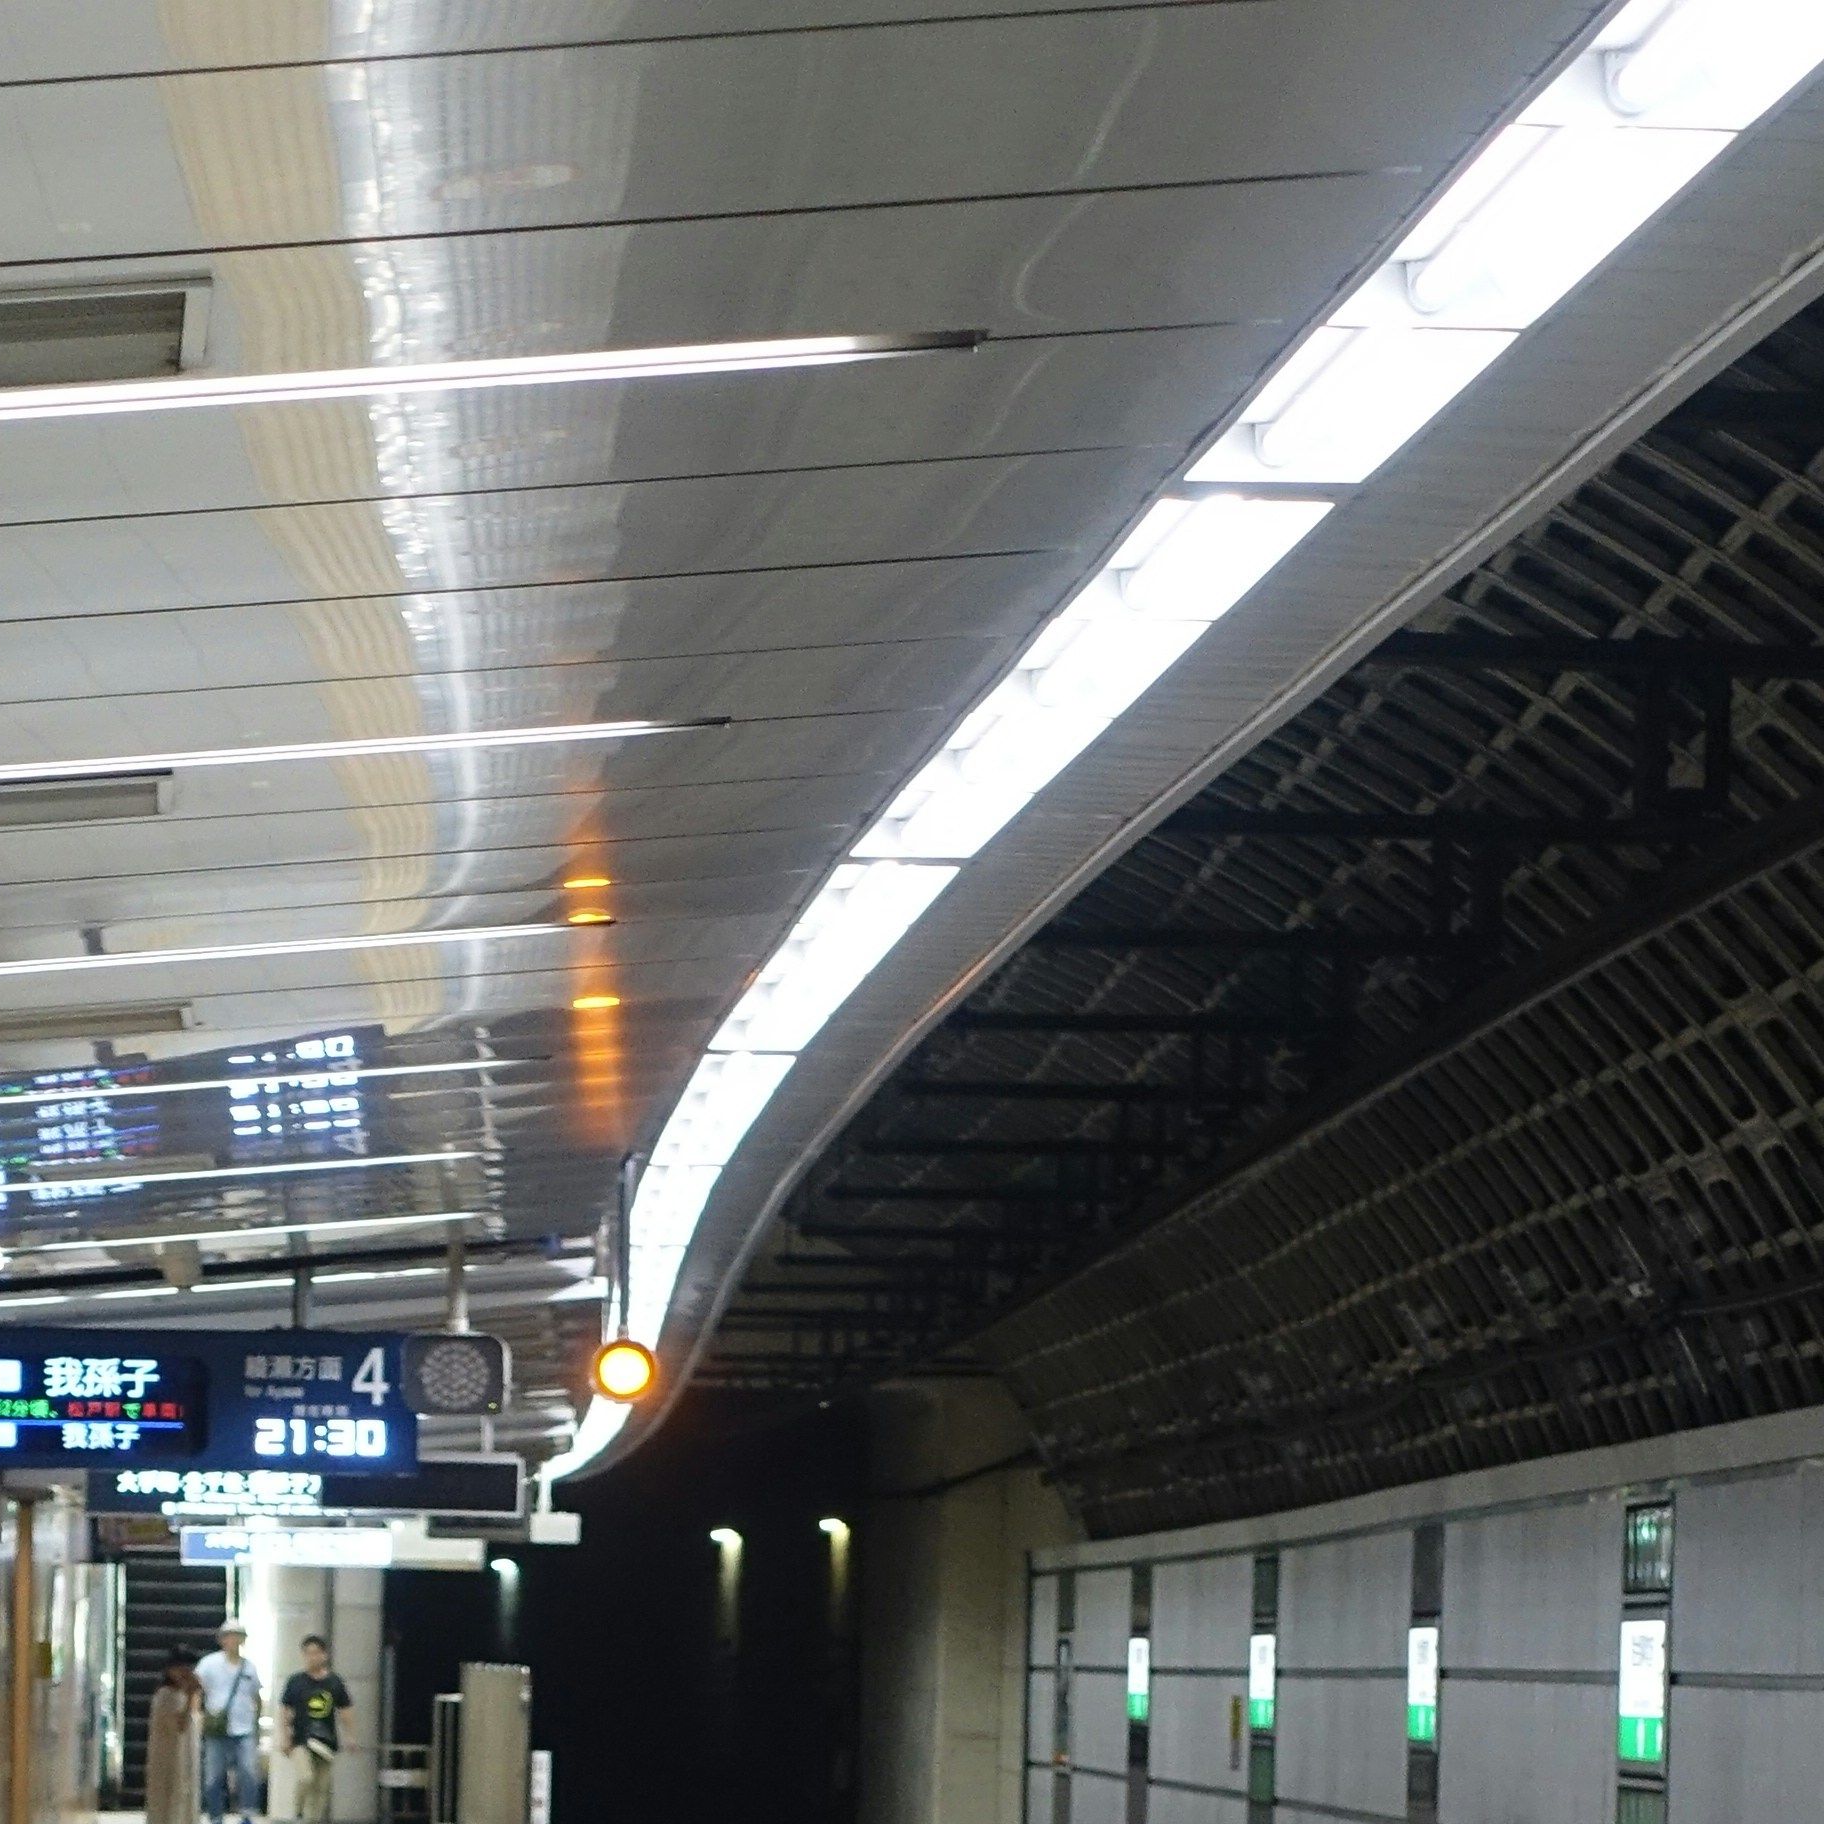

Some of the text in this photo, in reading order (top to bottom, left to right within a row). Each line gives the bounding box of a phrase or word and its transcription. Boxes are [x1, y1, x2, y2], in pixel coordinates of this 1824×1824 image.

[44, 1357, 160, 1399] 我孫子
[351, 1347, 392, 1407] 4
[62, 1422, 141, 1450] 我孫子
[254, 1418, 387, 1457] 21:30
